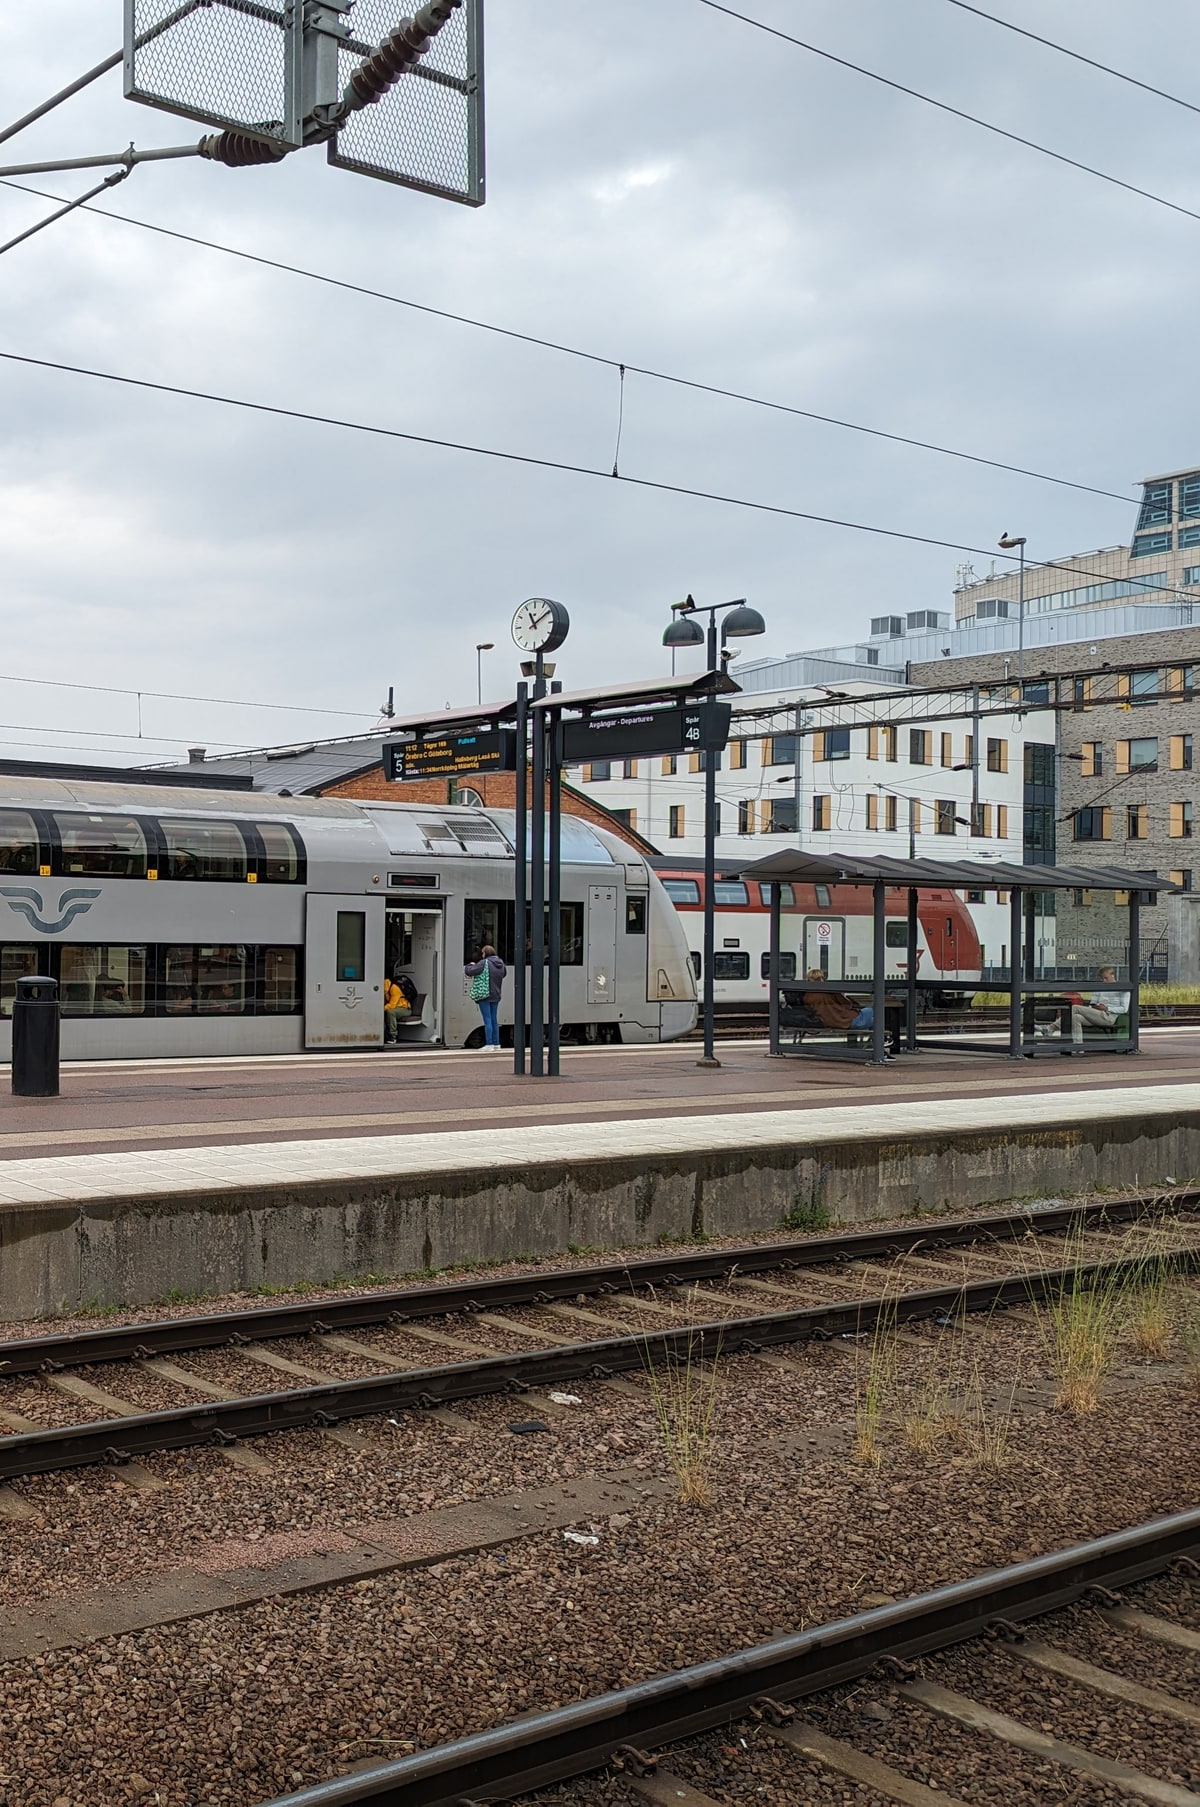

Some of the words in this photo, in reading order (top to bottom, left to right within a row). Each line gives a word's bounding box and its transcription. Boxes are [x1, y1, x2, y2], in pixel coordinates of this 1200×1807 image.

[589, 719, 616, 729] Avgångar
[621, 716, 653, 725] Departures
[685, 716, 700, 725] Spår
[685, 727, 700, 740] 4B
[395, 760, 403, 772] 5
[346, 986, 356, 997] SJ
